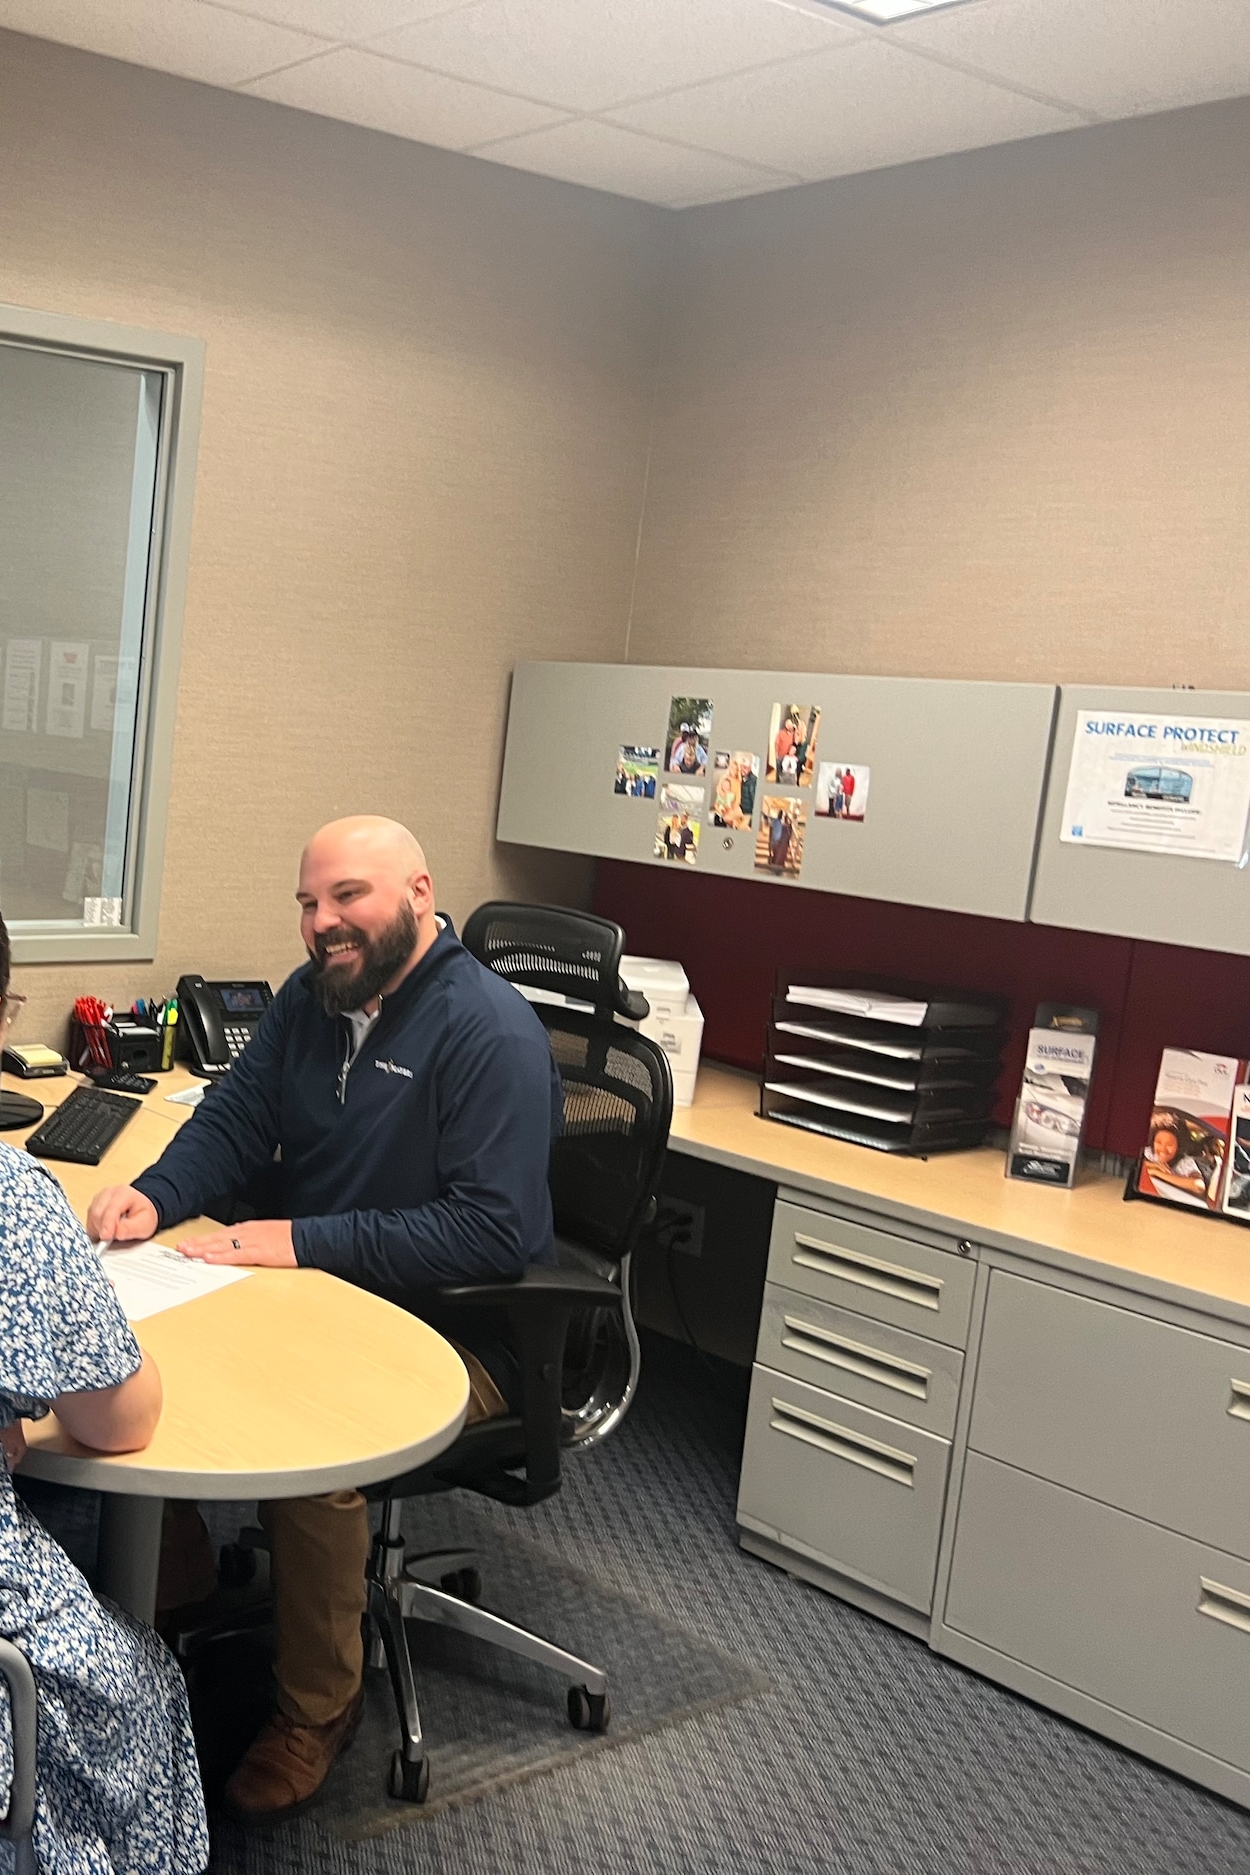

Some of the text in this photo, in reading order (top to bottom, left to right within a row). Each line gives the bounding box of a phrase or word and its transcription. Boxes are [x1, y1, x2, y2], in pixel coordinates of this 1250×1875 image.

[1085, 720, 1239, 744] SURFACE PROTECT
[1037, 1044, 1085, 1059] SURFACE
